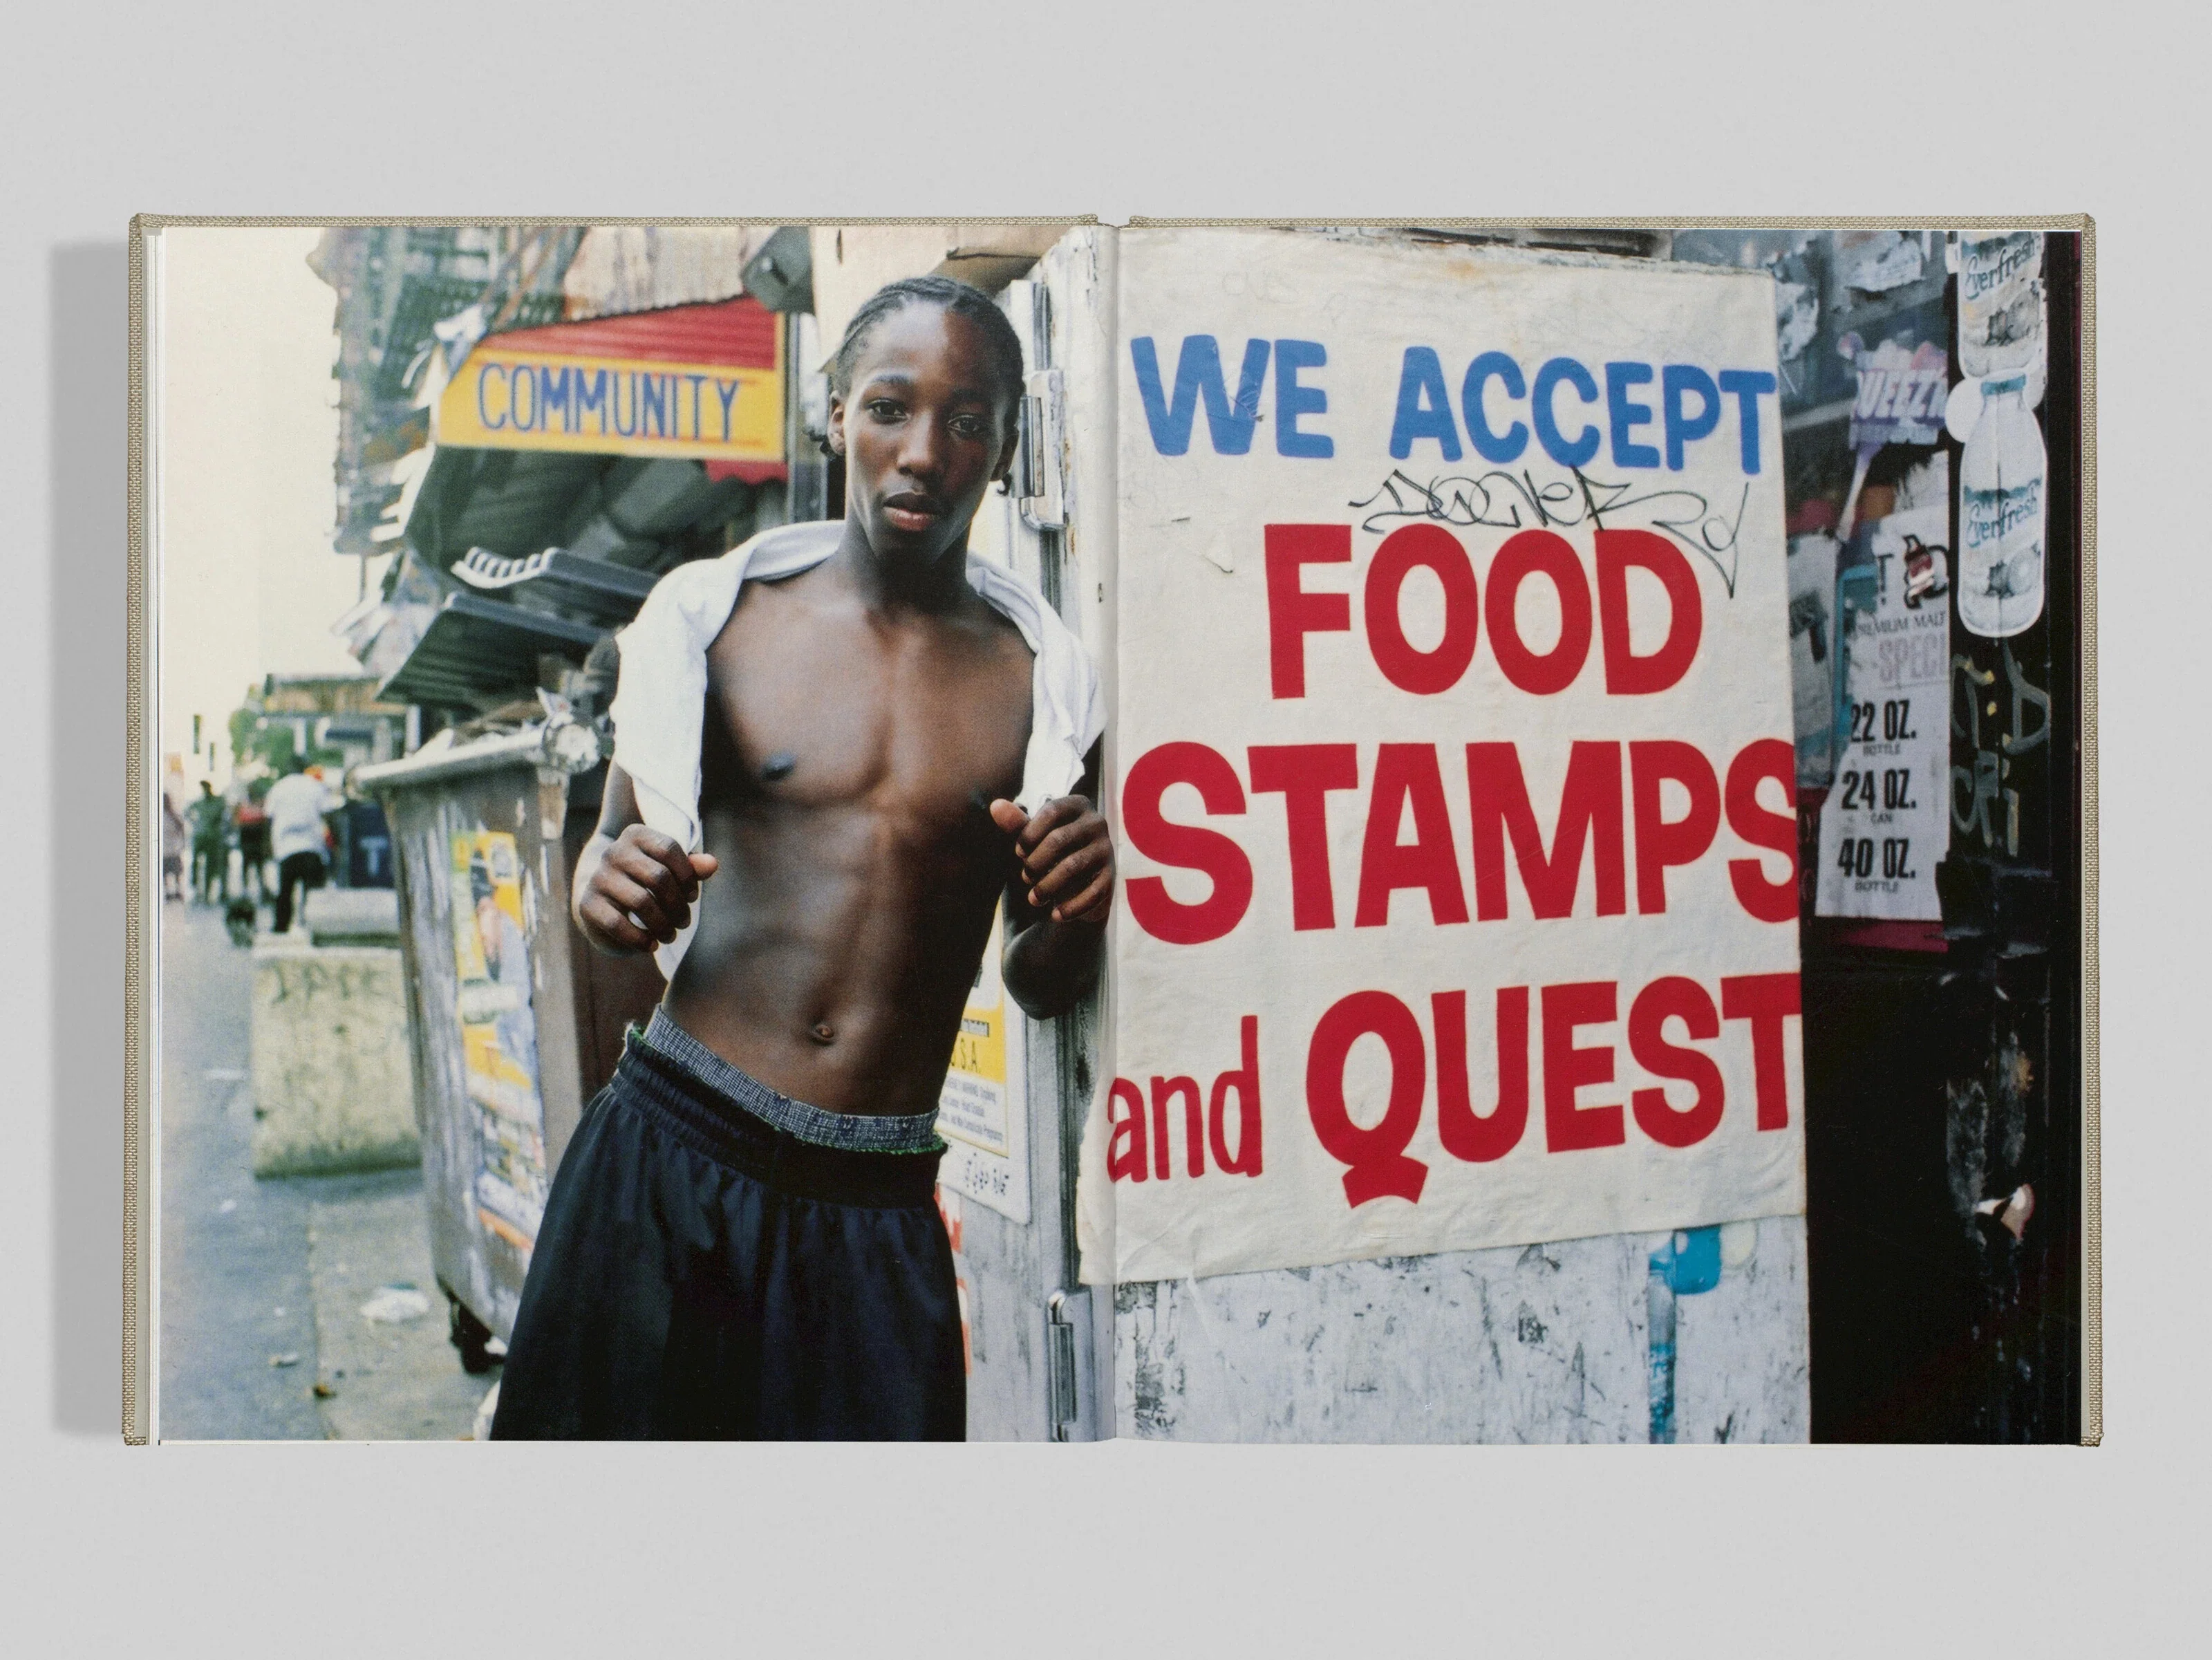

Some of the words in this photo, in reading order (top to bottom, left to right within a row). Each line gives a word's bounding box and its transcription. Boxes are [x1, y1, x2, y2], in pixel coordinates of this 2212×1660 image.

[478, 363, 740, 443] COMMUNITY
[1132, 335, 1333, 458] WE
[1390, 346, 1777, 474] ACCEPT
[1967, 489, 2038, 548] Everfresh
[1264, 523, 1703, 698] FOOD
[1850, 701, 1875, 743] 22
[1884, 699, 1917, 740] OZ.
[1863, 743, 1901, 756] BOTTLE
[1841, 769, 1875, 810] 24
[1884, 768, 1917, 809] OZ.
[1123, 739, 1799, 944] STAMPS
[1837, 838, 1874, 878] 40
[1883, 837, 1916, 879] OZ.
[1855, 879, 1900, 894] BOTTLE
[1107, 1016, 1263, 1182] and
[1306, 973, 1801, 1207] QUEST
